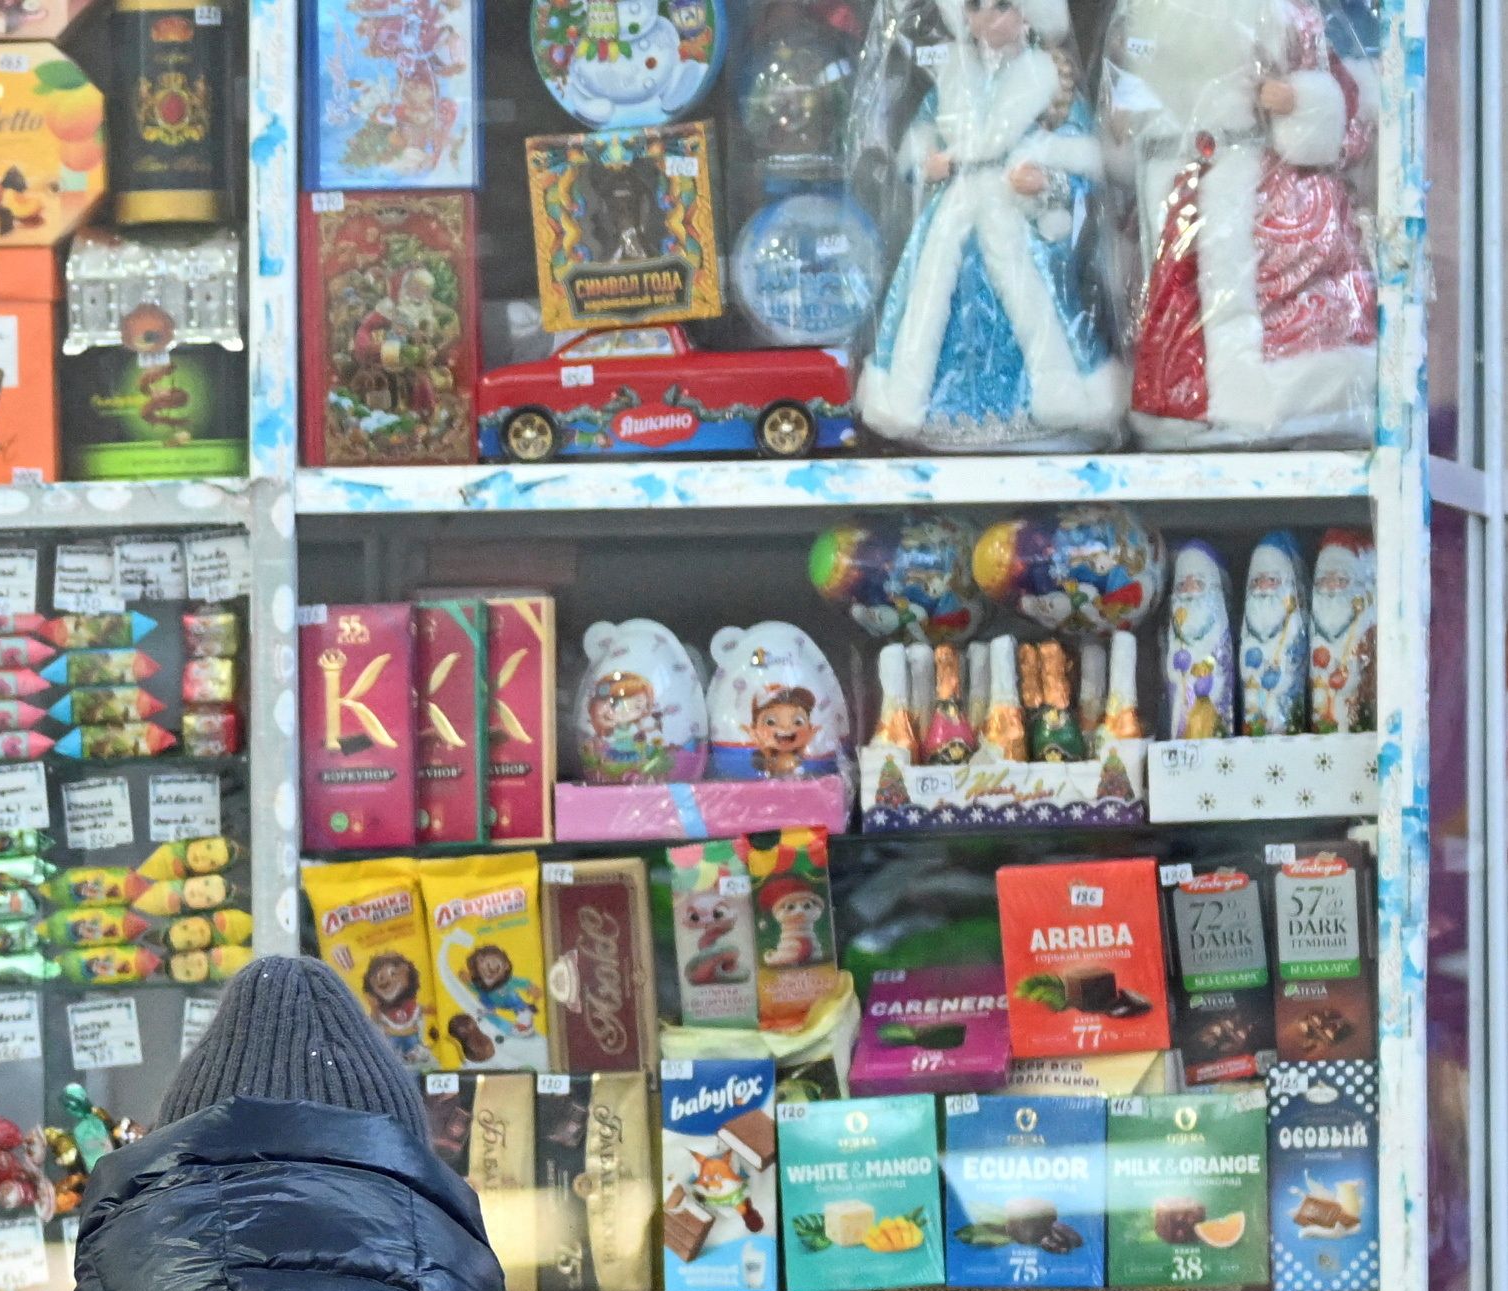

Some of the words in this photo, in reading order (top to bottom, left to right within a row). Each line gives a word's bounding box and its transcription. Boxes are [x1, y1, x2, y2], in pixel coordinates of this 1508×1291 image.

[618, 413, 694, 439] Яшкино
[1029, 923, 1135, 953] ARRIBA
[1189, 930, 1254, 953] DARK
[1288, 918, 1348, 939] DARK
[670, 1074, 764, 1122] babyfox
[1278, 1120, 1370, 1150] ОСОБЫЙ
[786, 1163, 848, 1184] WHITE
[866, 1157, 933, 1178] MANGO
[962, 1157, 1090, 1181] ECUADOR
[1114, 1155, 1162, 1176] MILK
[1177, 1153, 1261, 1176] ORANGE
